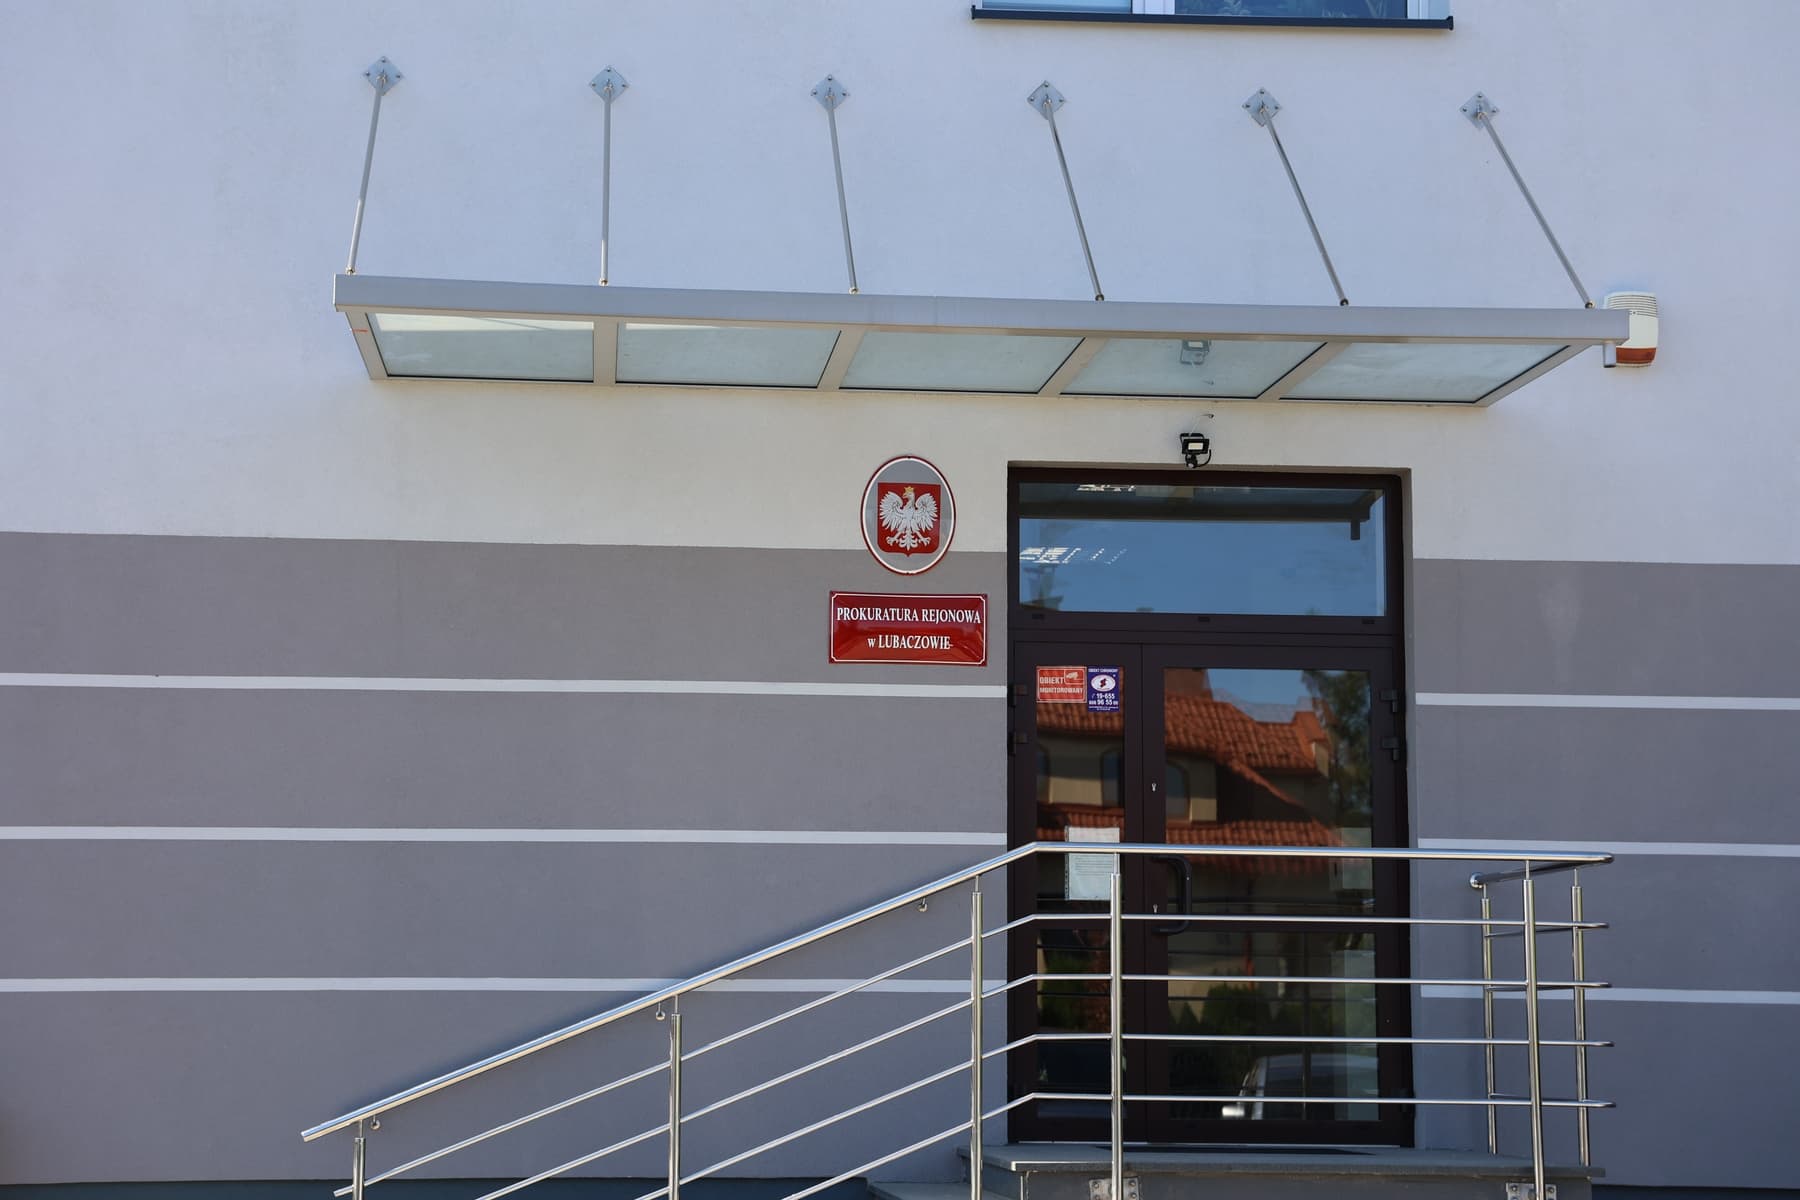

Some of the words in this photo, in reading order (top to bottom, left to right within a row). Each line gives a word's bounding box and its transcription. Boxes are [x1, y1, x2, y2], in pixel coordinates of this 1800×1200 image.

[836, 607, 918, 622] PROKURATURA
[921, 608, 981, 624] REJONOWA
[867, 637, 876, 648] w
[878, 634, 951, 650] LUBACZOWIE
